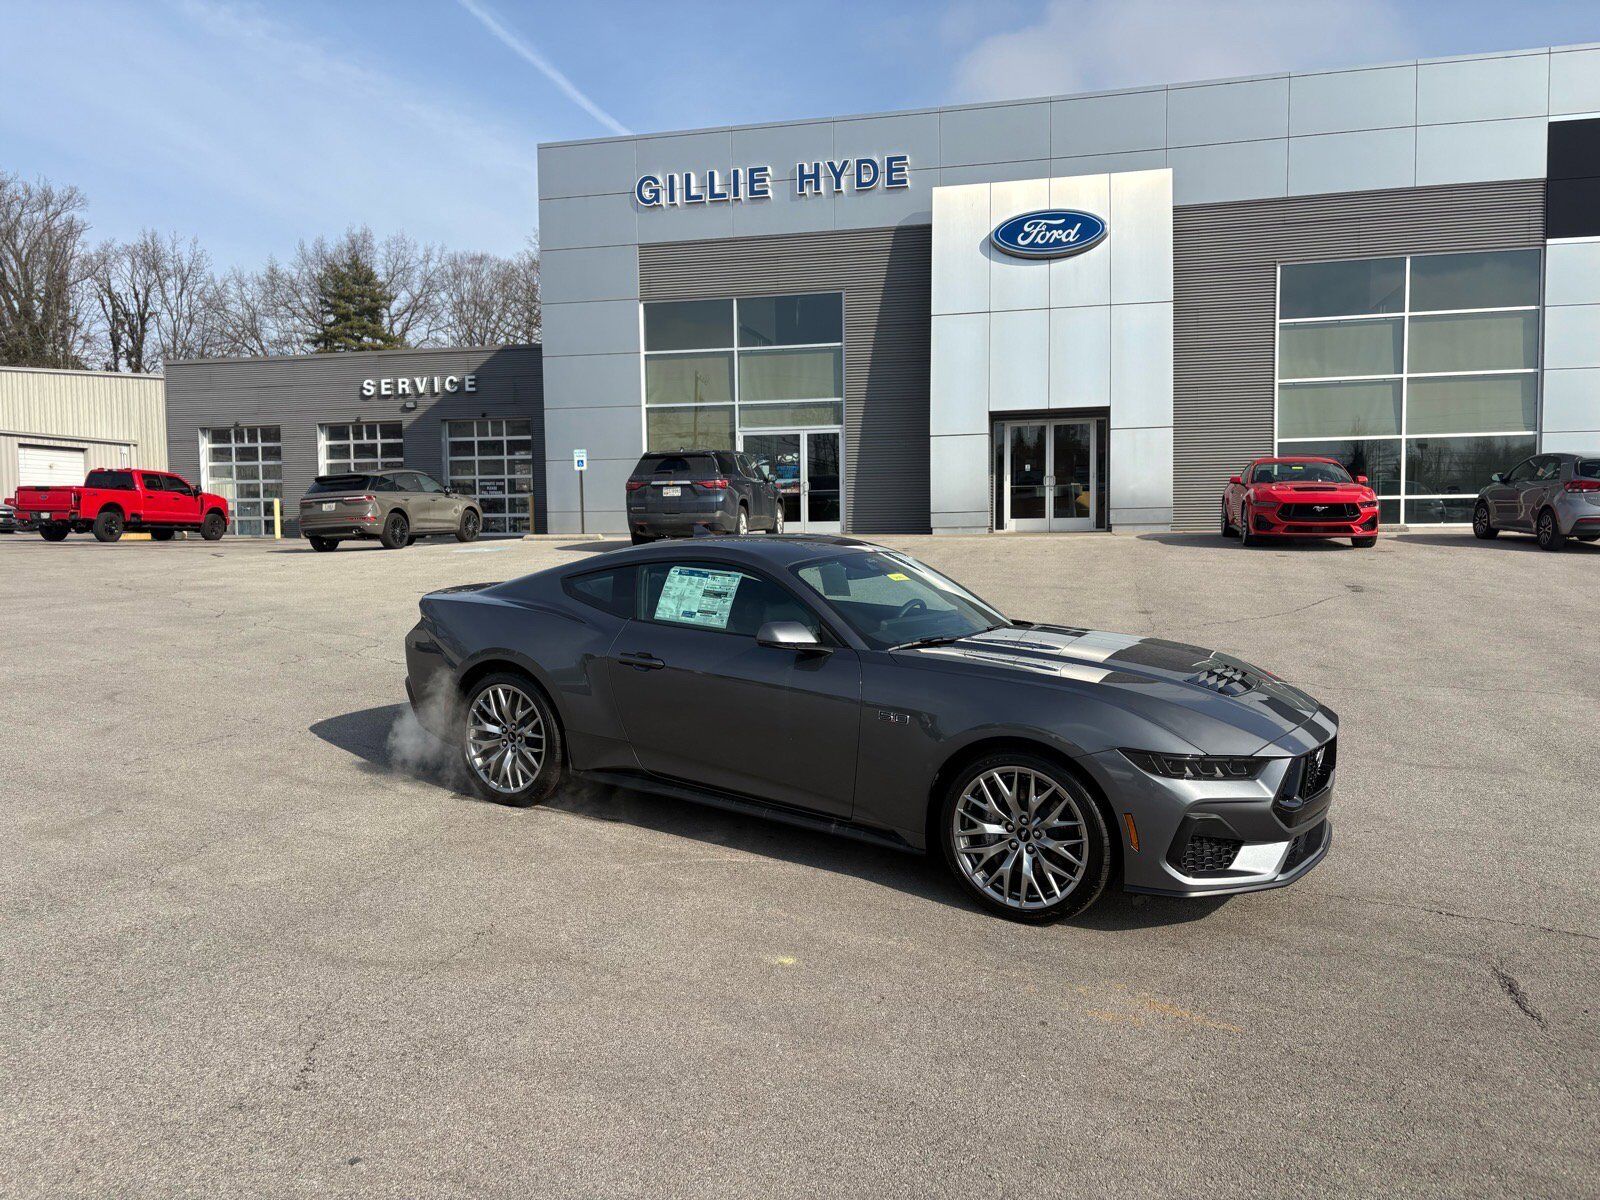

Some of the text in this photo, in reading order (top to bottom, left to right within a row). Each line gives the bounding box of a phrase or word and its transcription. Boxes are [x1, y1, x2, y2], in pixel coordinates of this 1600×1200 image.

[635, 155, 909, 207] GILLIE HYDE
[1017, 218, 1082, 246] Ford
[361, 375, 477, 397] SERVICE
